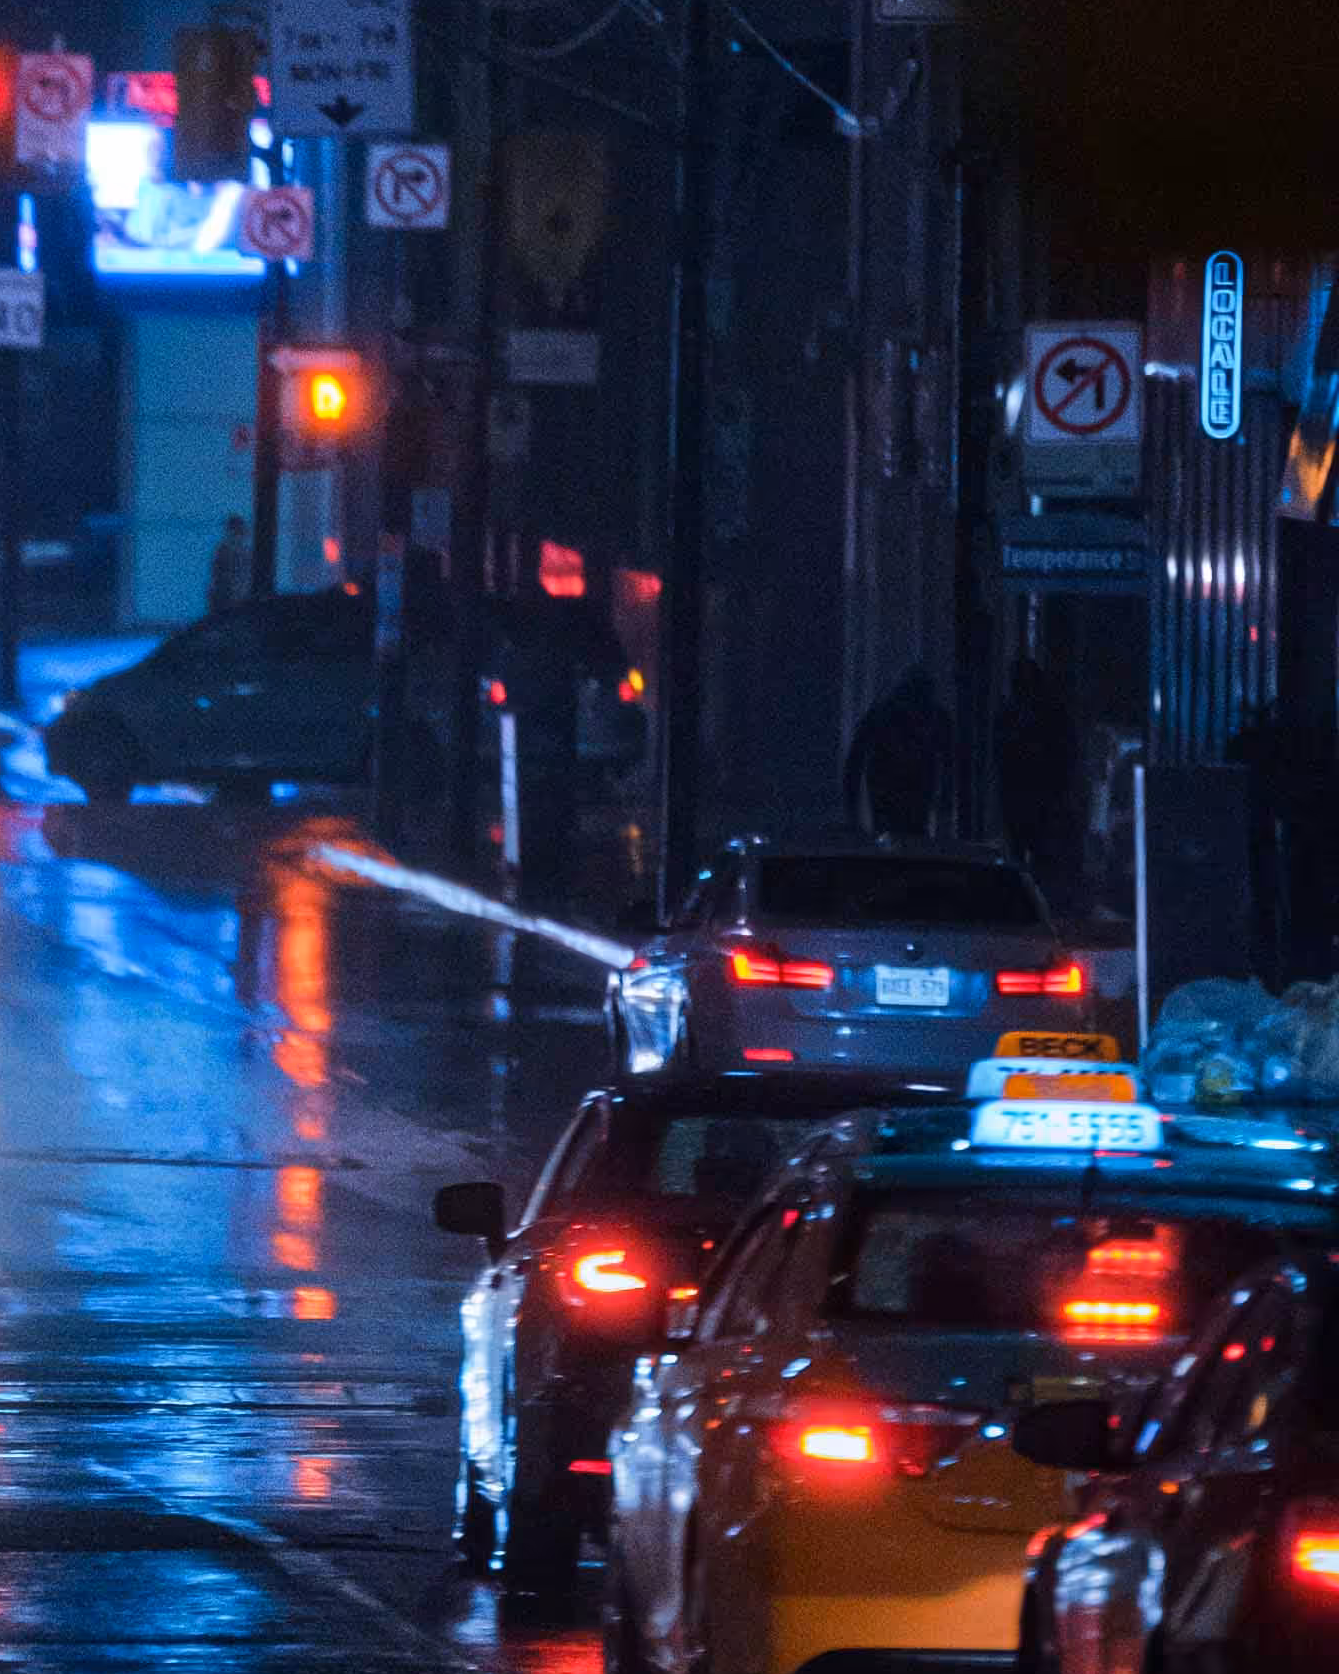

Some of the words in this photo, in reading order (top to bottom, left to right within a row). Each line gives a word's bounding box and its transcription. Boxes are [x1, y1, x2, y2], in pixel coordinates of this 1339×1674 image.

[1210, 262, 1236, 424] LOCALE
[1003, 546, 1122, 572] Temperance
[1019, 1036, 1102, 1059] BECK
